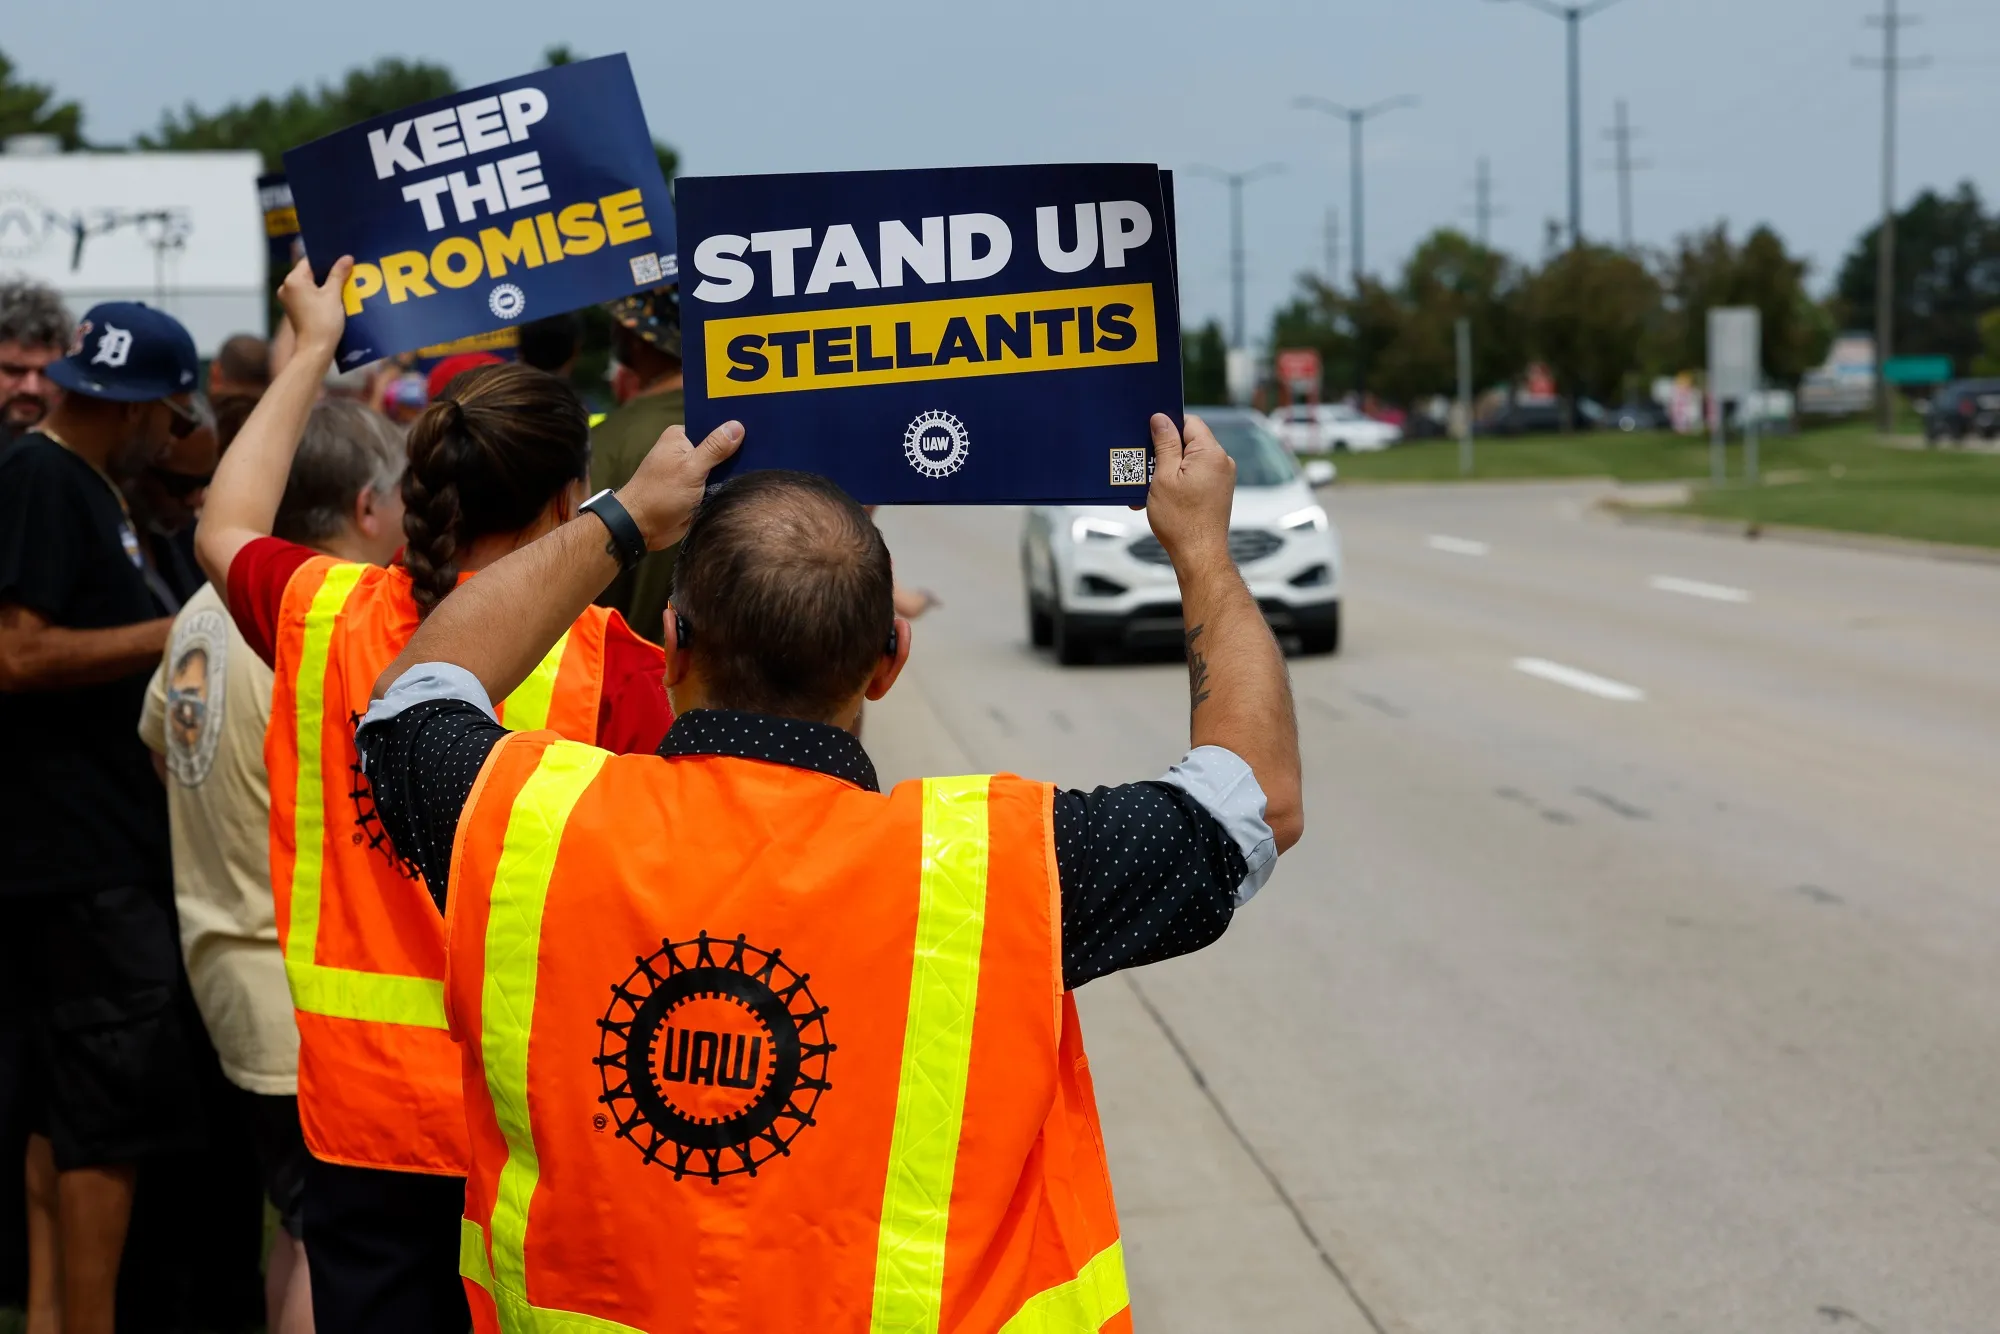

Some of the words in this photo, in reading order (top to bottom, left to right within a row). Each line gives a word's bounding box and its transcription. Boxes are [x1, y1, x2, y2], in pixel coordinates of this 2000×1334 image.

[367, 87, 549, 180] KEEP
[402, 150, 551, 232] THE
[343, 188, 652, 317] PROMISE
[692, 212, 1013, 303] STAND
[1036, 200, 1153, 273] UP
[91, 321, 133, 368] D
[726, 303, 1137, 382] STELLANTIS
[922, 436, 949, 451] UAW
[662, 1026, 762, 1090] UAW
